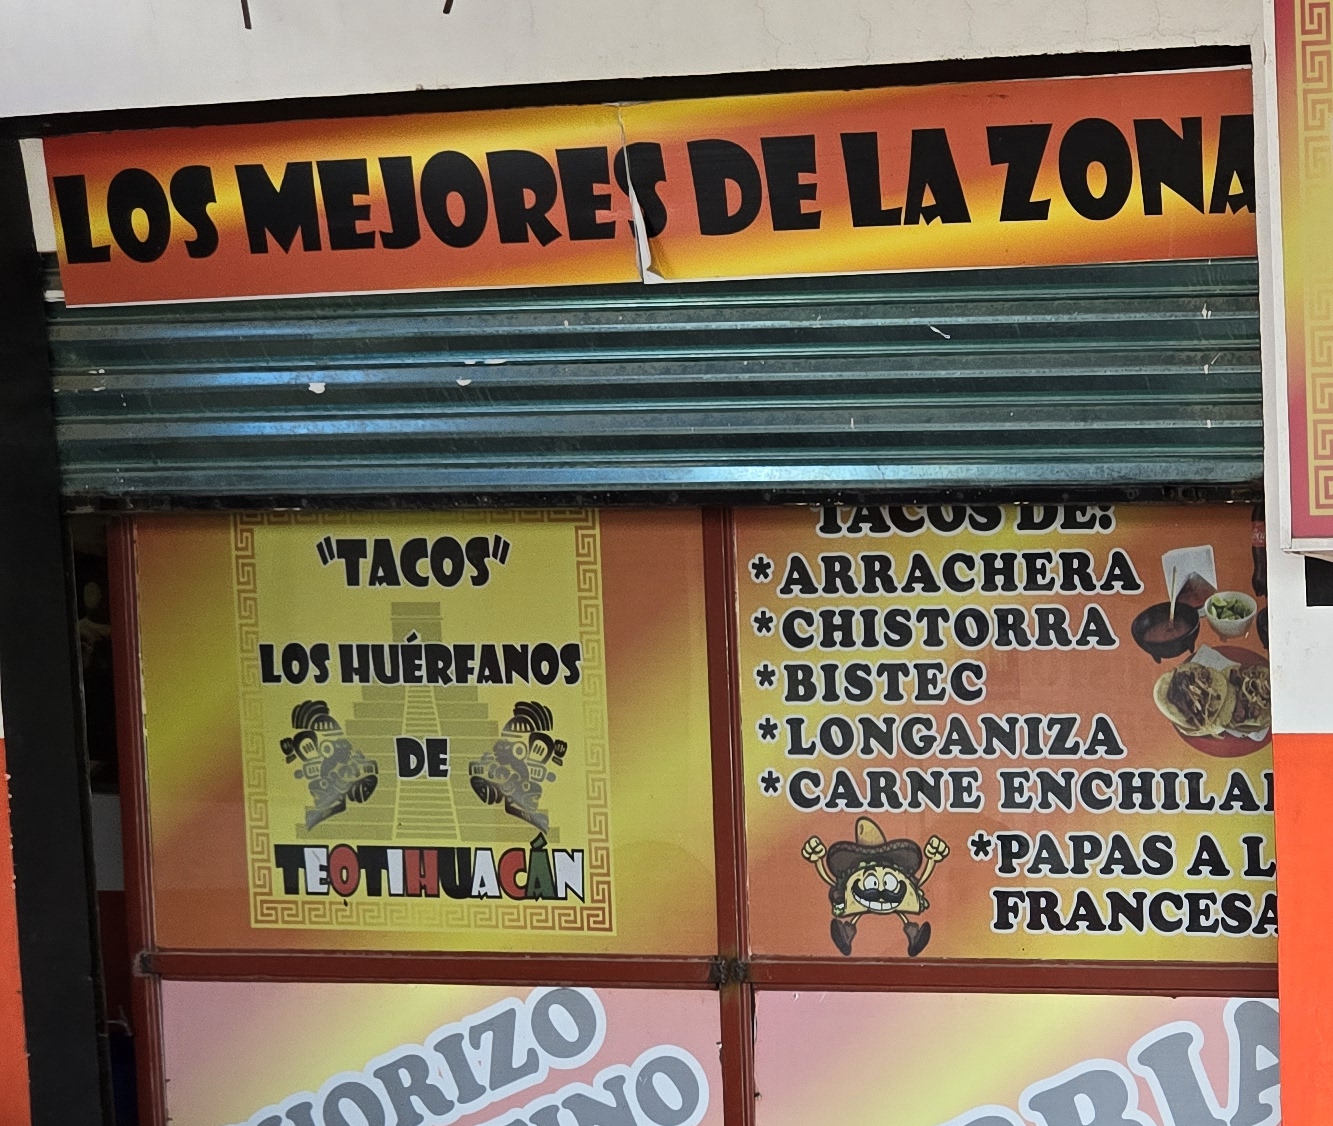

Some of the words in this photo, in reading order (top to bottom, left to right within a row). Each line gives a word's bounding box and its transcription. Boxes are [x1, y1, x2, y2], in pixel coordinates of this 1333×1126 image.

[53, 165, 219, 265] LOS
[234, 142, 667, 255] MEJORES
[687, 134, 822, 236] DE
[840, 128, 972, 228] LA
[986, 114, 1256, 222] ZONA
[819, 505, 1002, 533] TACOS
[779, 552, 1141, 594] ARRACHERA
[782, 607, 1117, 648] CHISTORRA
[259, 643, 330, 685] LOS
[339, 632, 582, 686] HUÉRFANOS
[784, 663, 984, 702] BISTEC
[396, 737, 450, 779] DE
[786, 717, 1125, 757] LONGANIZA
[789, 771, 982, 810] CARNE
[274, 833, 586, 904] TEOTIHUACÁN
[997, 834, 1174, 876] PAPAS
[1186, 834, 1231, 877] A
[993, 891, 1278, 935] FRANCESA
